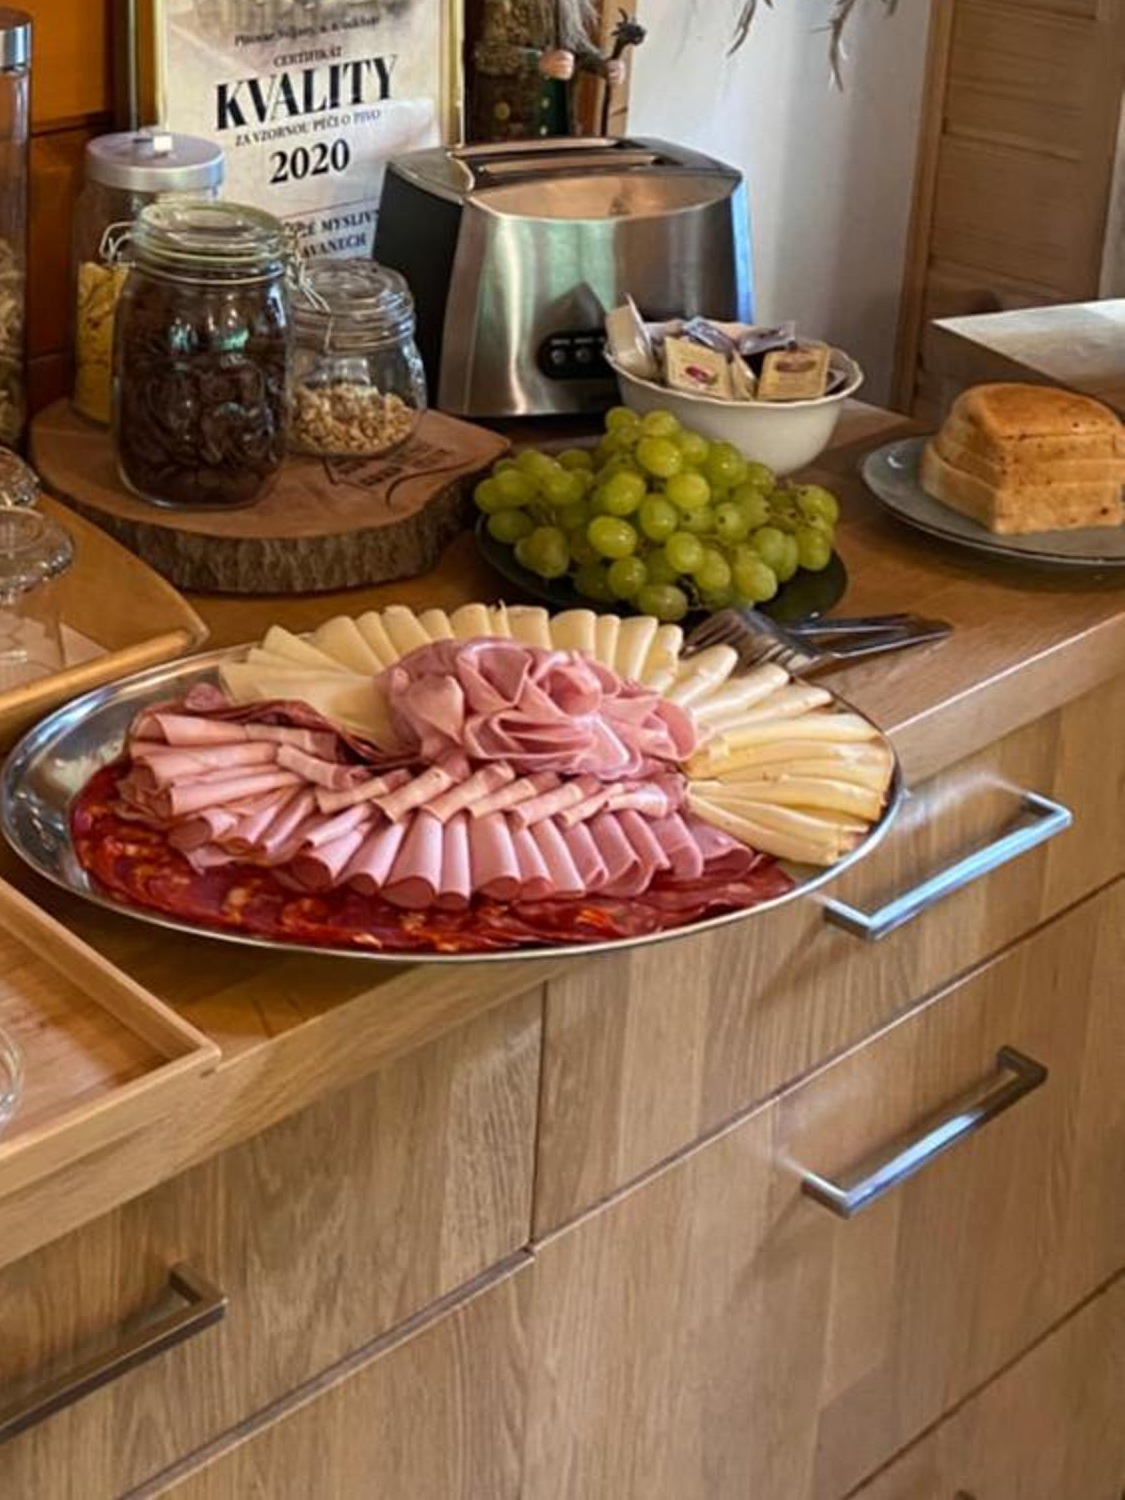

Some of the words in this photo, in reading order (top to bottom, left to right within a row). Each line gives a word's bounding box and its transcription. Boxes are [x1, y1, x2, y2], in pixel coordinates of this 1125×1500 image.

[216, 54, 398, 131] KVALITY
[235, 133, 251, 147] ZA
[252, 119, 312, 143] VZORNOU
[341, 115, 351, 125] O
[353, 109, 381, 124] PIVO
[269, 137, 351, 185] 2020
